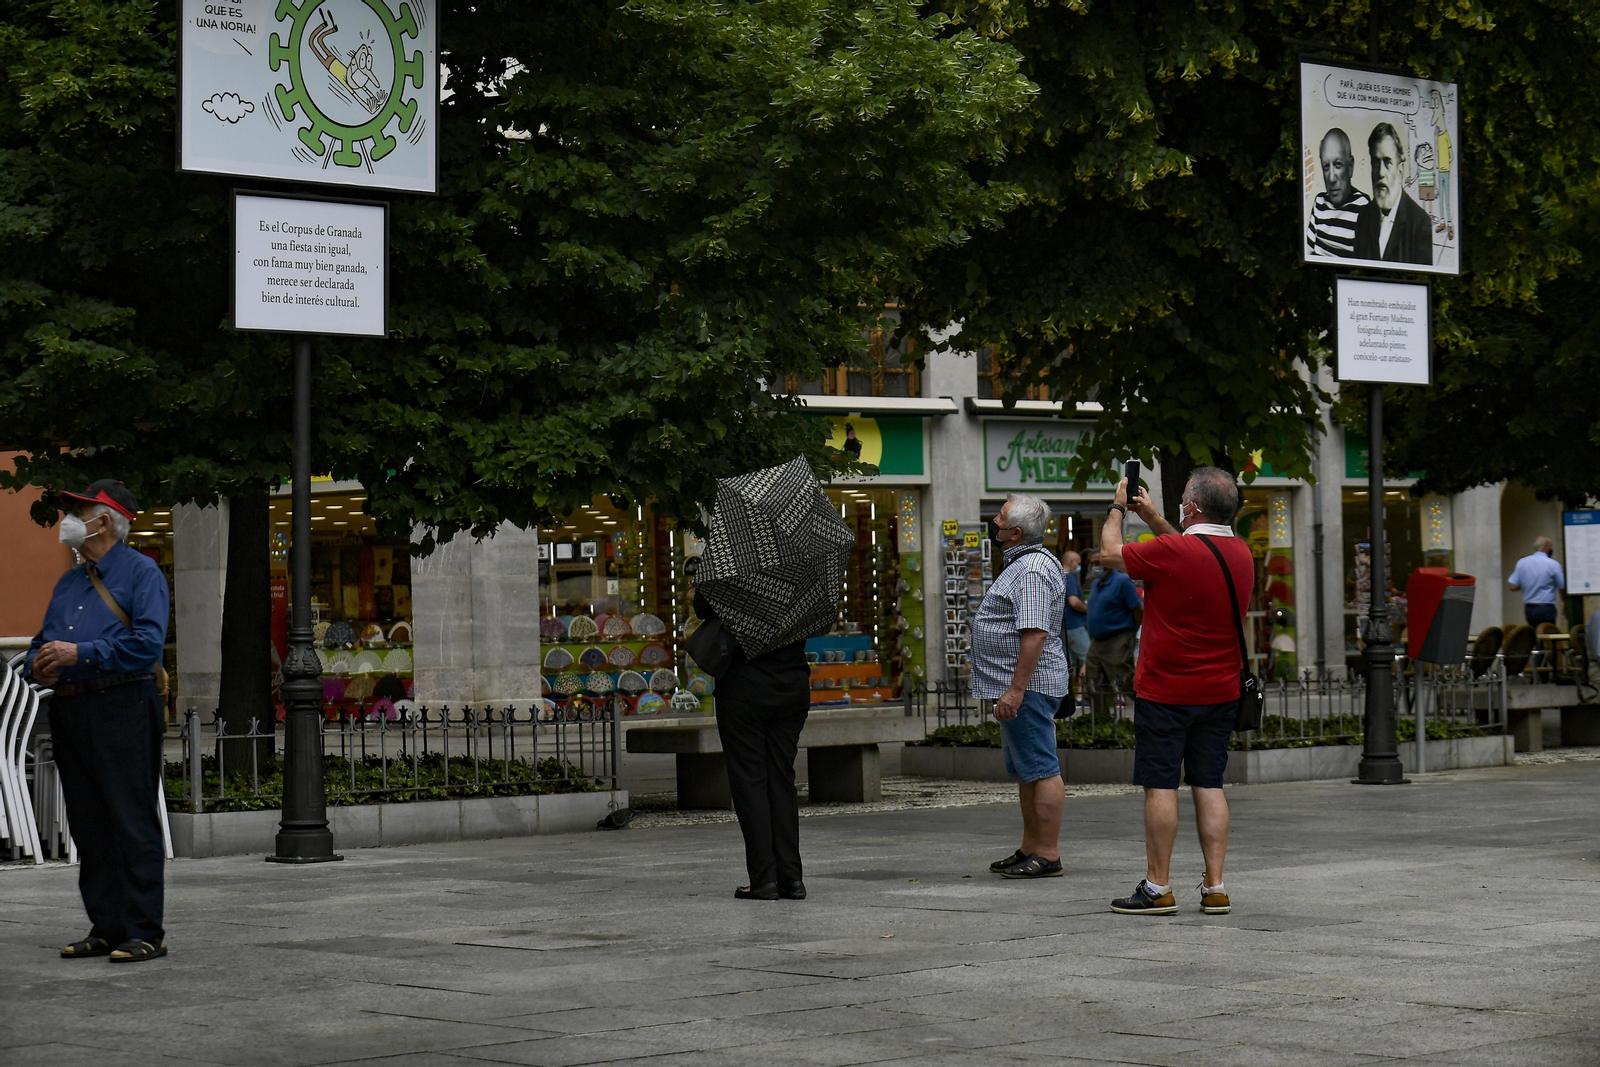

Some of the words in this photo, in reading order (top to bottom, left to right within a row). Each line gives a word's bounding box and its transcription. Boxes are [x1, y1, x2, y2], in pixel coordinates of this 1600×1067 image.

[205, 5, 227, 16] QUE
[229, 7, 243, 18] ES
[196, 18, 218, 29] UNA
[221, 21, 256, 34] NORIA!
[1355, 82, 1372, 92] ¿QUIÉN
[1373, 84, 1381, 93] ES
[1382, 85, 1392, 94] ESE
[1393, 86, 1411, 96] HOMBRE
[1336, 91, 1348, 99] QUE
[1357, 94, 1367, 102] CON
[1367, 95, 1389, 104] MARIANO
[1389, 97, 1415, 107] FORTUNY?
[259, 220, 270, 232] Es
[271, 221, 279, 233] el
[281, 222, 313, 237] Corpus
[314, 224, 325, 236] de
[327, 226, 362, 239] Granada
[271, 242, 288, 251] una
[290, 240, 312, 252] fiesta
[314, 242, 326, 254] sin
[328, 243, 351, 257] igual,
[253, 258, 269, 267] con
[271, 256, 293, 269] fama
[295, 261, 314, 273] muy
[316, 259, 334, 271] bien
[335, 262, 367, 275] ganada,
[267, 276, 298, 286] merece
[300, 278, 313, 287] ser
[314, 277, 355, 290] declarada
[262, 291, 281, 303] bien
[283, 292, 294, 304] de
[295, 294, 324, 306] interés
[325, 295, 360, 308] cultural.
[1347, 297, 1359, 306] Han
[1360, 299, 1388, 308] nombrado
[1389, 301, 1416, 311] embajador
[1350, 311, 1355, 320] al
[1356, 314, 1368, 322] gran
[1369, 312, 1390, 324] Fortuny
[1359, 338, 1388, 348] adelantado
